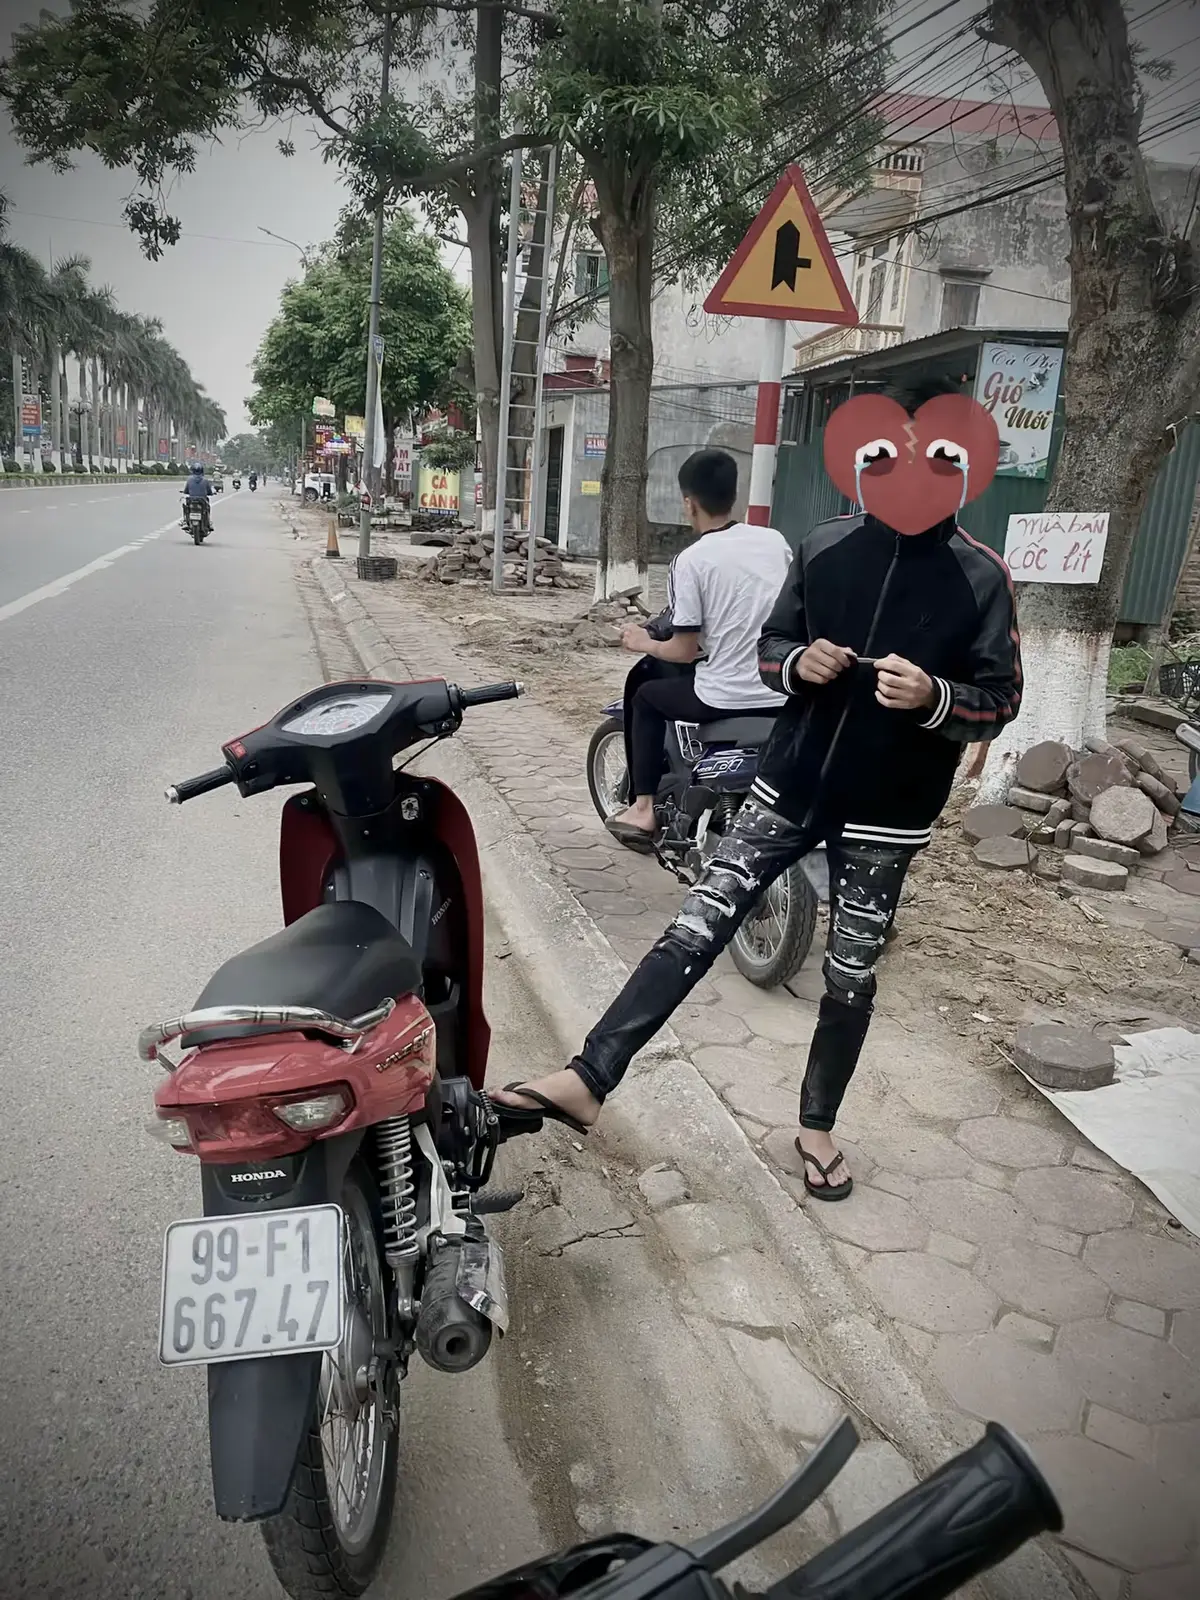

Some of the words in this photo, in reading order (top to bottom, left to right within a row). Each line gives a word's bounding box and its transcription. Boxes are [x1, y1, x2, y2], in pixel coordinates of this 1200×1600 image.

[984, 371, 1026, 413] Gió
[1005, 406, 1053, 430] Mới
[420, 491, 459, 508] CẢNH
[431, 897, 452, 925] HONDA
[231, 1169, 286, 1183] HONDA
[191, 1218, 310, 1285] 99-F1
[173, 1280, 329, 1354] 667.47
